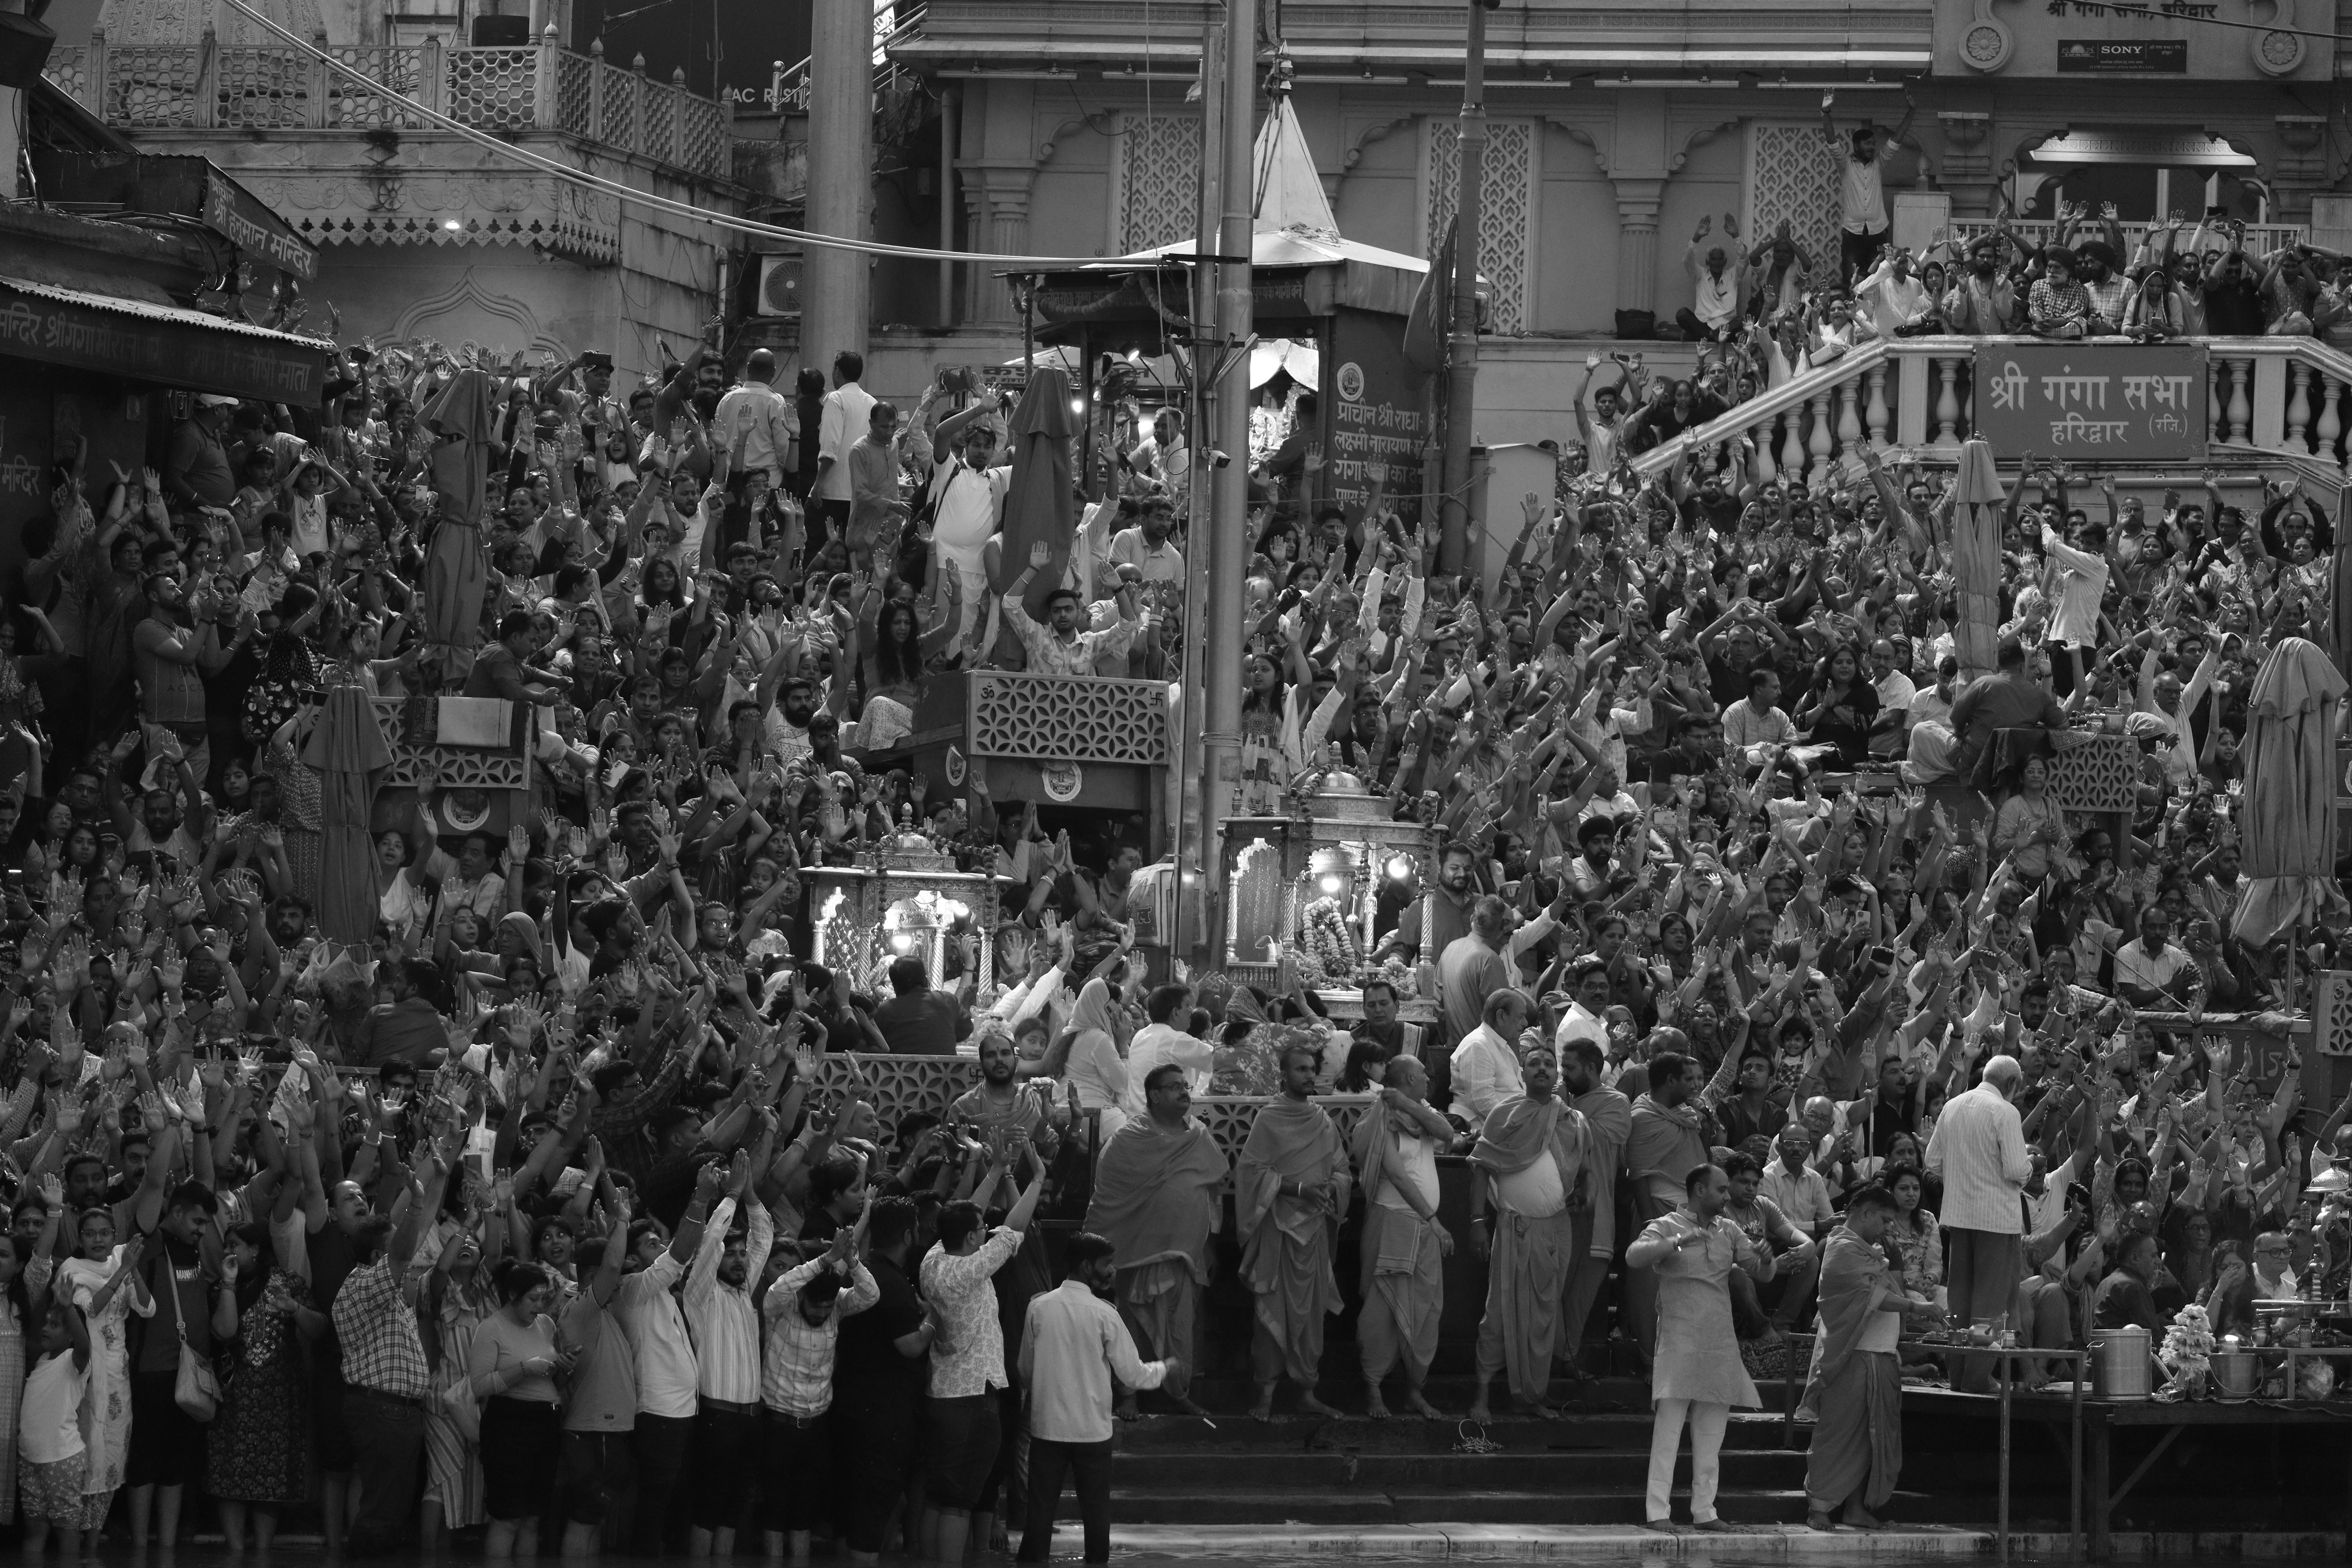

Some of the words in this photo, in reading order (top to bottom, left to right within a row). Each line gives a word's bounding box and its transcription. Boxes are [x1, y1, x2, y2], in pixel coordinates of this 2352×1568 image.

[2101, 46, 2142, 54] SONY
[732, 87, 755, 103] AC
[214, 196, 227, 227] श्री
[229, 208, 268, 250] हनुमान
[1989, 361, 2029, 411] श्री
[2041, 364, 2110, 411] गंगा
[2122, 374, 2193, 411] सभा
[1337, 397, 1377, 426] प्राचीन
[1378, 401, 1394, 428] श्री
[2050, 412, 2129, 446] हरिद्वार
[2, 454, 40, 496] मन्दिर
[2256, 1047, 2282, 1080] 15
